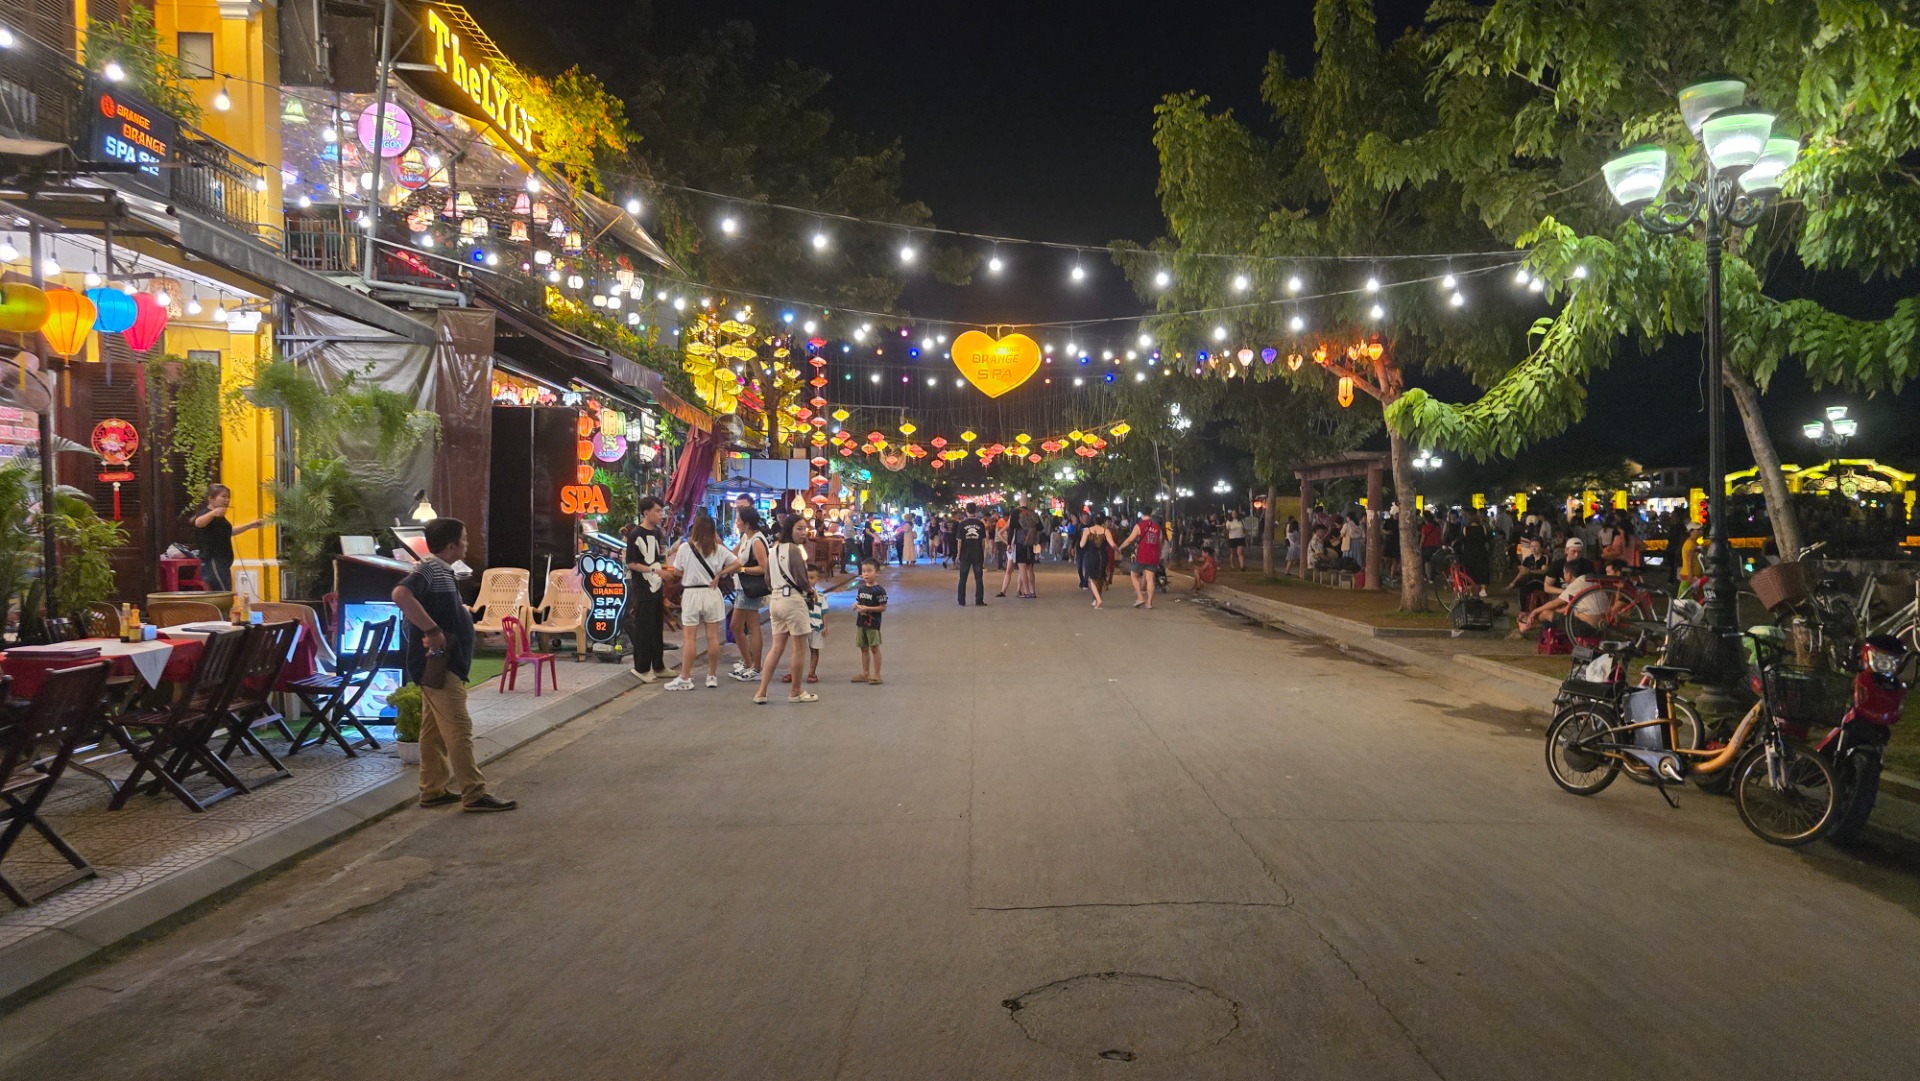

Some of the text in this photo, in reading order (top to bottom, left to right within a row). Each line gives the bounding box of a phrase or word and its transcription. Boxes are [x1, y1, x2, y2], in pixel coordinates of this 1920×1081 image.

[116, 103, 151, 131] ORANGE
[122, 122, 167, 157] ORANGE
[104, 135, 137, 163] SPA
[972, 353, 1020, 364] ORANGE
[977, 368, 1013, 379] SPA
[560, 484, 609, 514] SPA
[592, 588, 624, 596] ORANGE
[595, 597, 622, 606] SPA
[595, 621, 607, 631] 82
